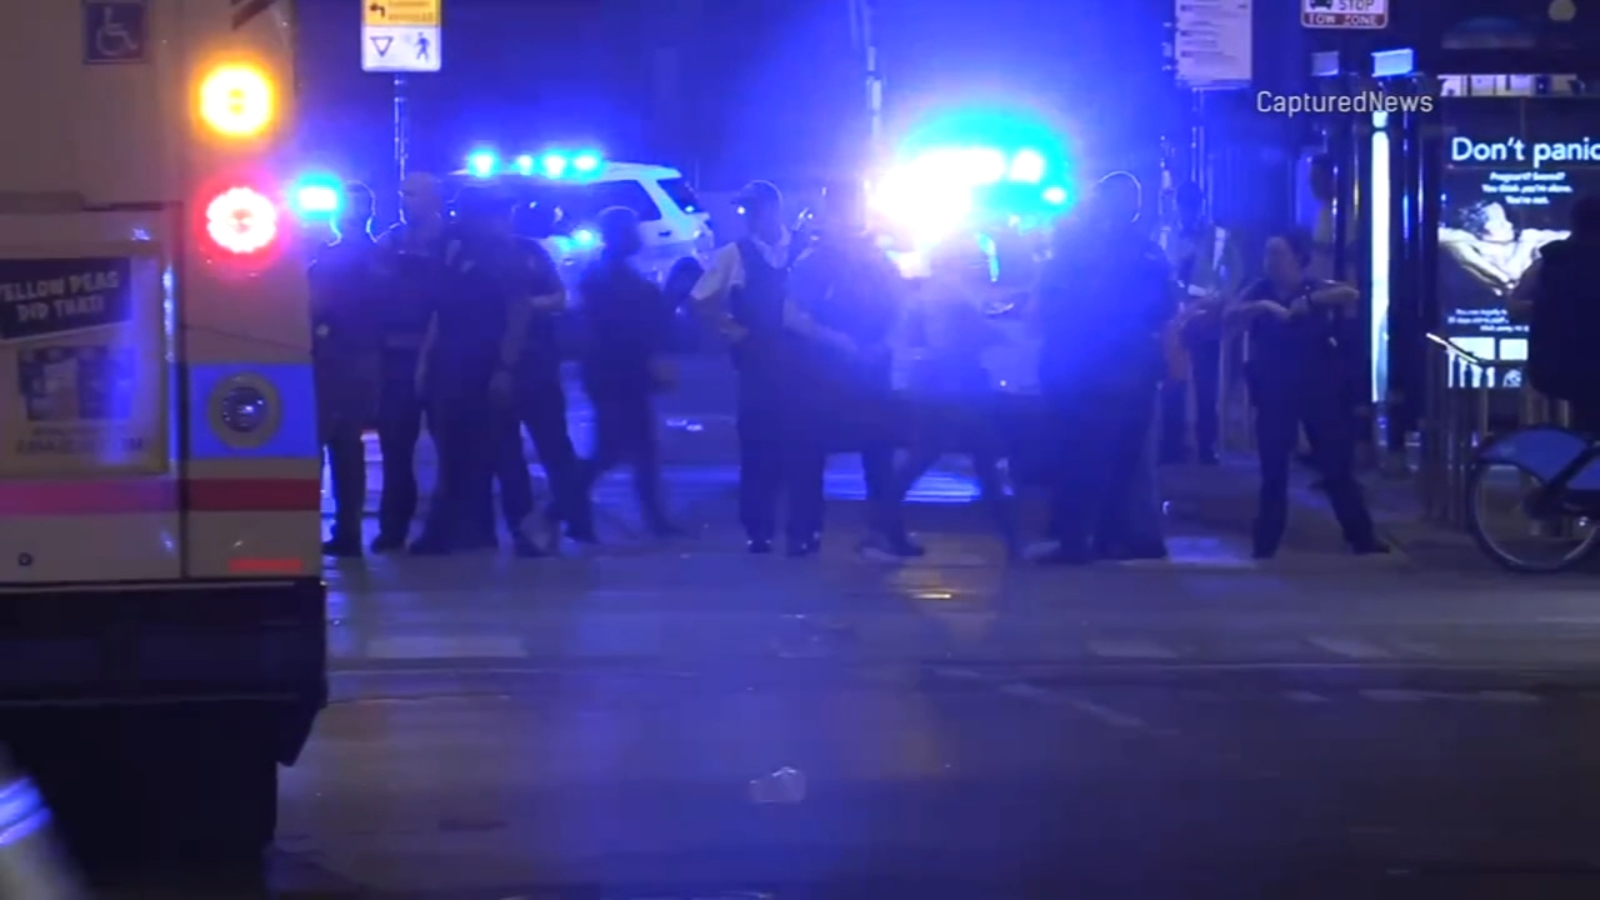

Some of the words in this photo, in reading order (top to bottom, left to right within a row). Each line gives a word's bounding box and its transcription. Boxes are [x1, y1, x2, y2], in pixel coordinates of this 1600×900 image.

[1343, 14, 1378, 26] ZONE
[1452, 137, 1525, 161] Don't
[69, 271, 119, 294] PEAS
[16, 302, 49, 321] DID
